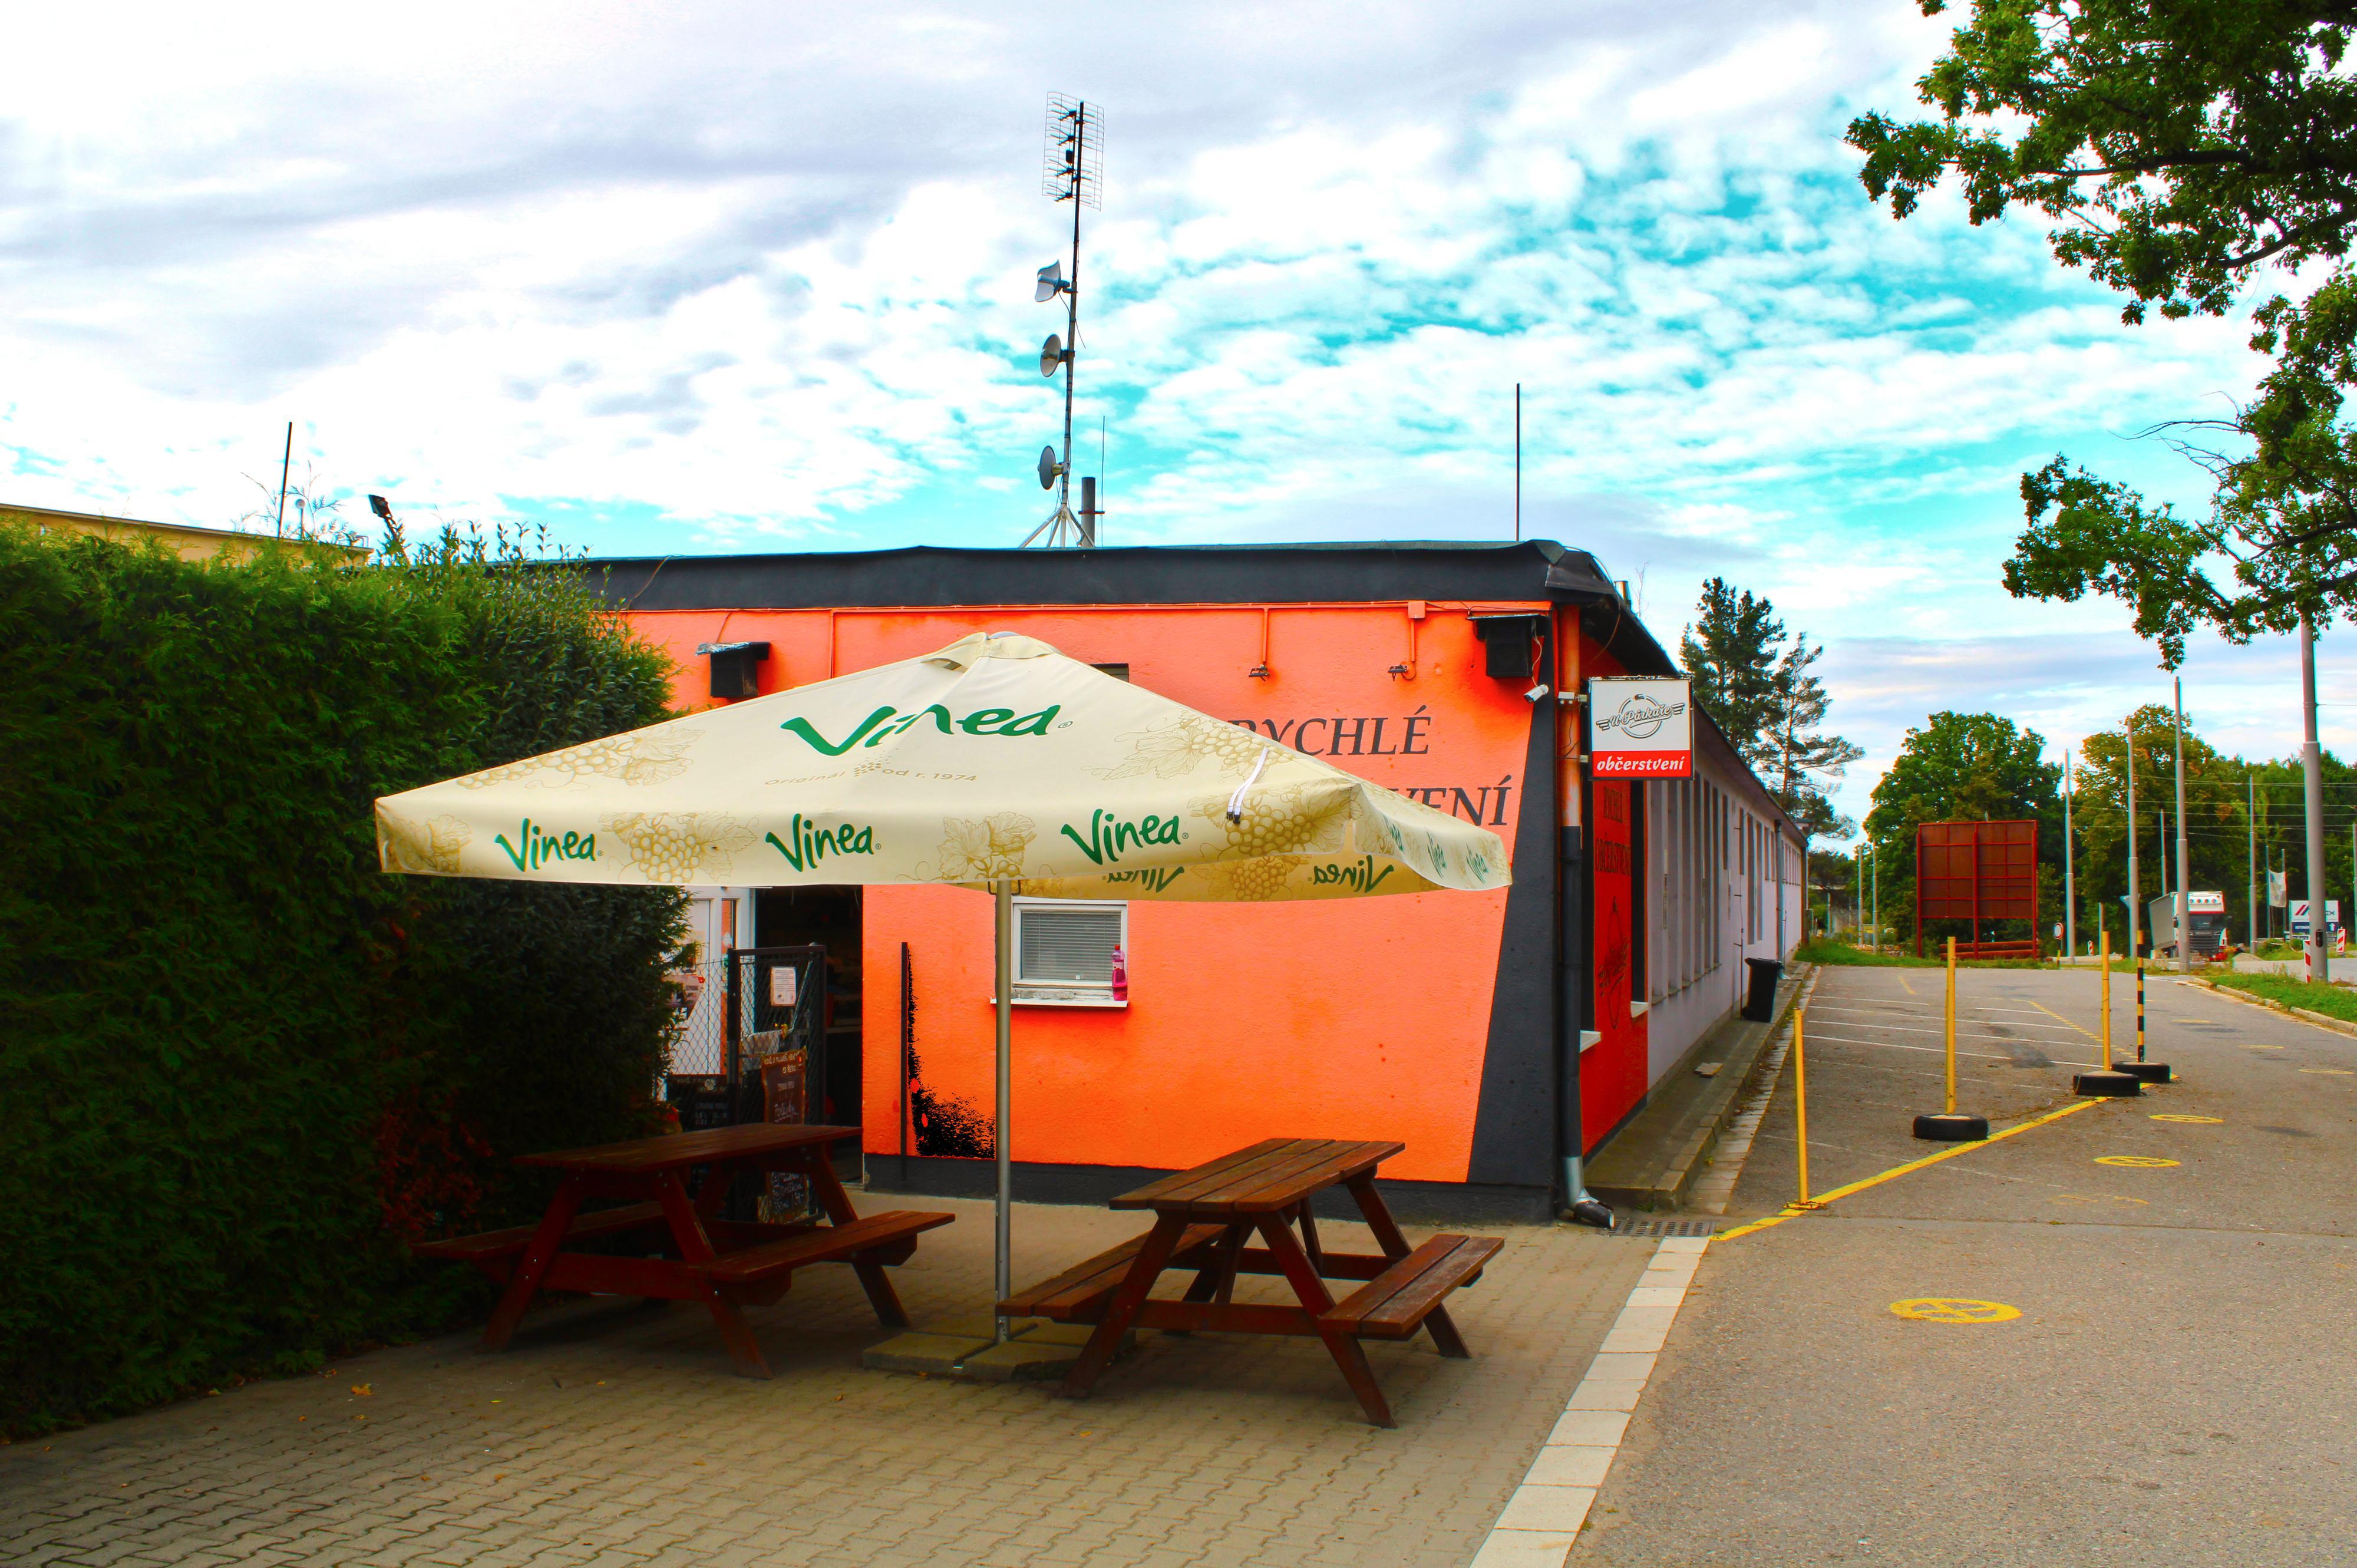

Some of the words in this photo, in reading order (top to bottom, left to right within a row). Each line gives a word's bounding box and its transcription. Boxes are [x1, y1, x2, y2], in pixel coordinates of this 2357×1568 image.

[780, 704, 1061, 756] Vinea
[1609, 715, 1620, 727] U
[1622, 704, 1672, 724] Párkaře
[933, 773, 978, 781] 1974
[1597, 755, 1685, 771] občerstvení
[494, 818, 596, 872] Vinea
[765, 813, 874, 872] Vinea
[1061, 808, 1181, 865] Vinea
